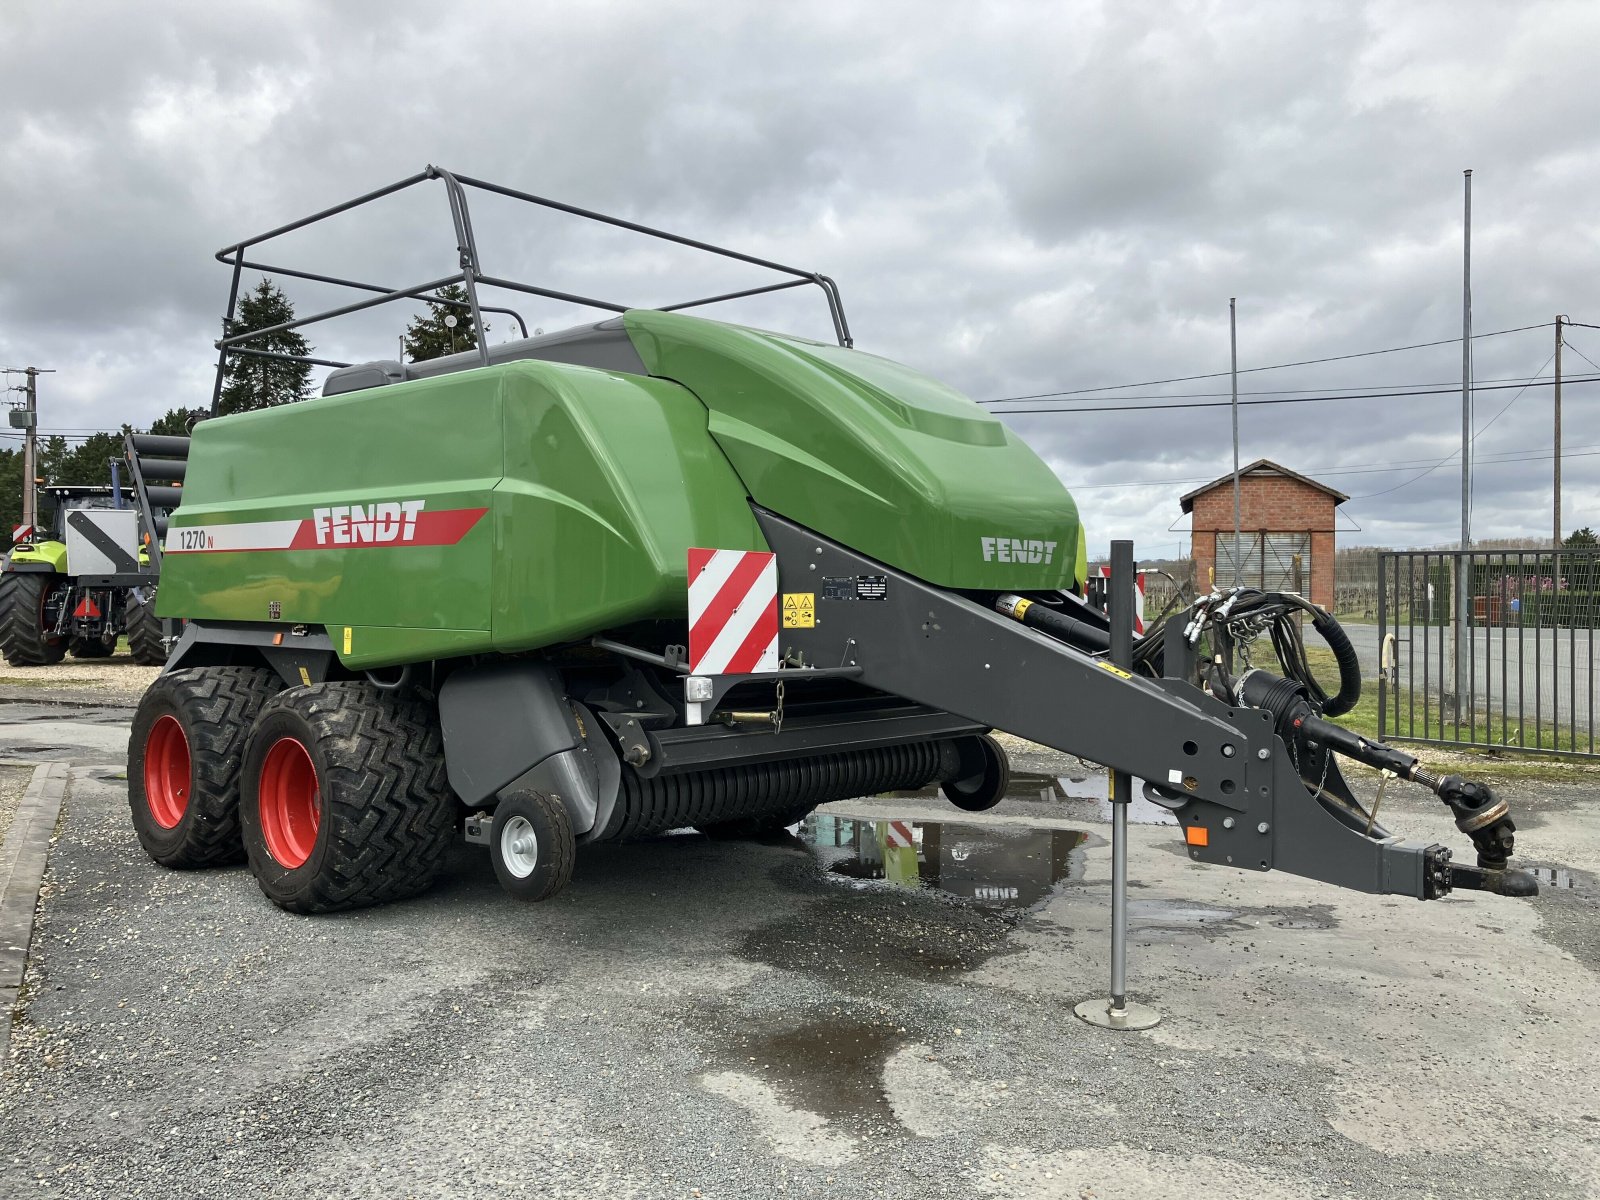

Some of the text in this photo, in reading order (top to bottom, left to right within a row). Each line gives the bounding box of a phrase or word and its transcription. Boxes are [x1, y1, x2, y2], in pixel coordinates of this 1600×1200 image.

[313, 499, 426, 545] FENDT
[180, 530, 213, 550] 1270 N
[981, 537, 1057, 564] FENDT
